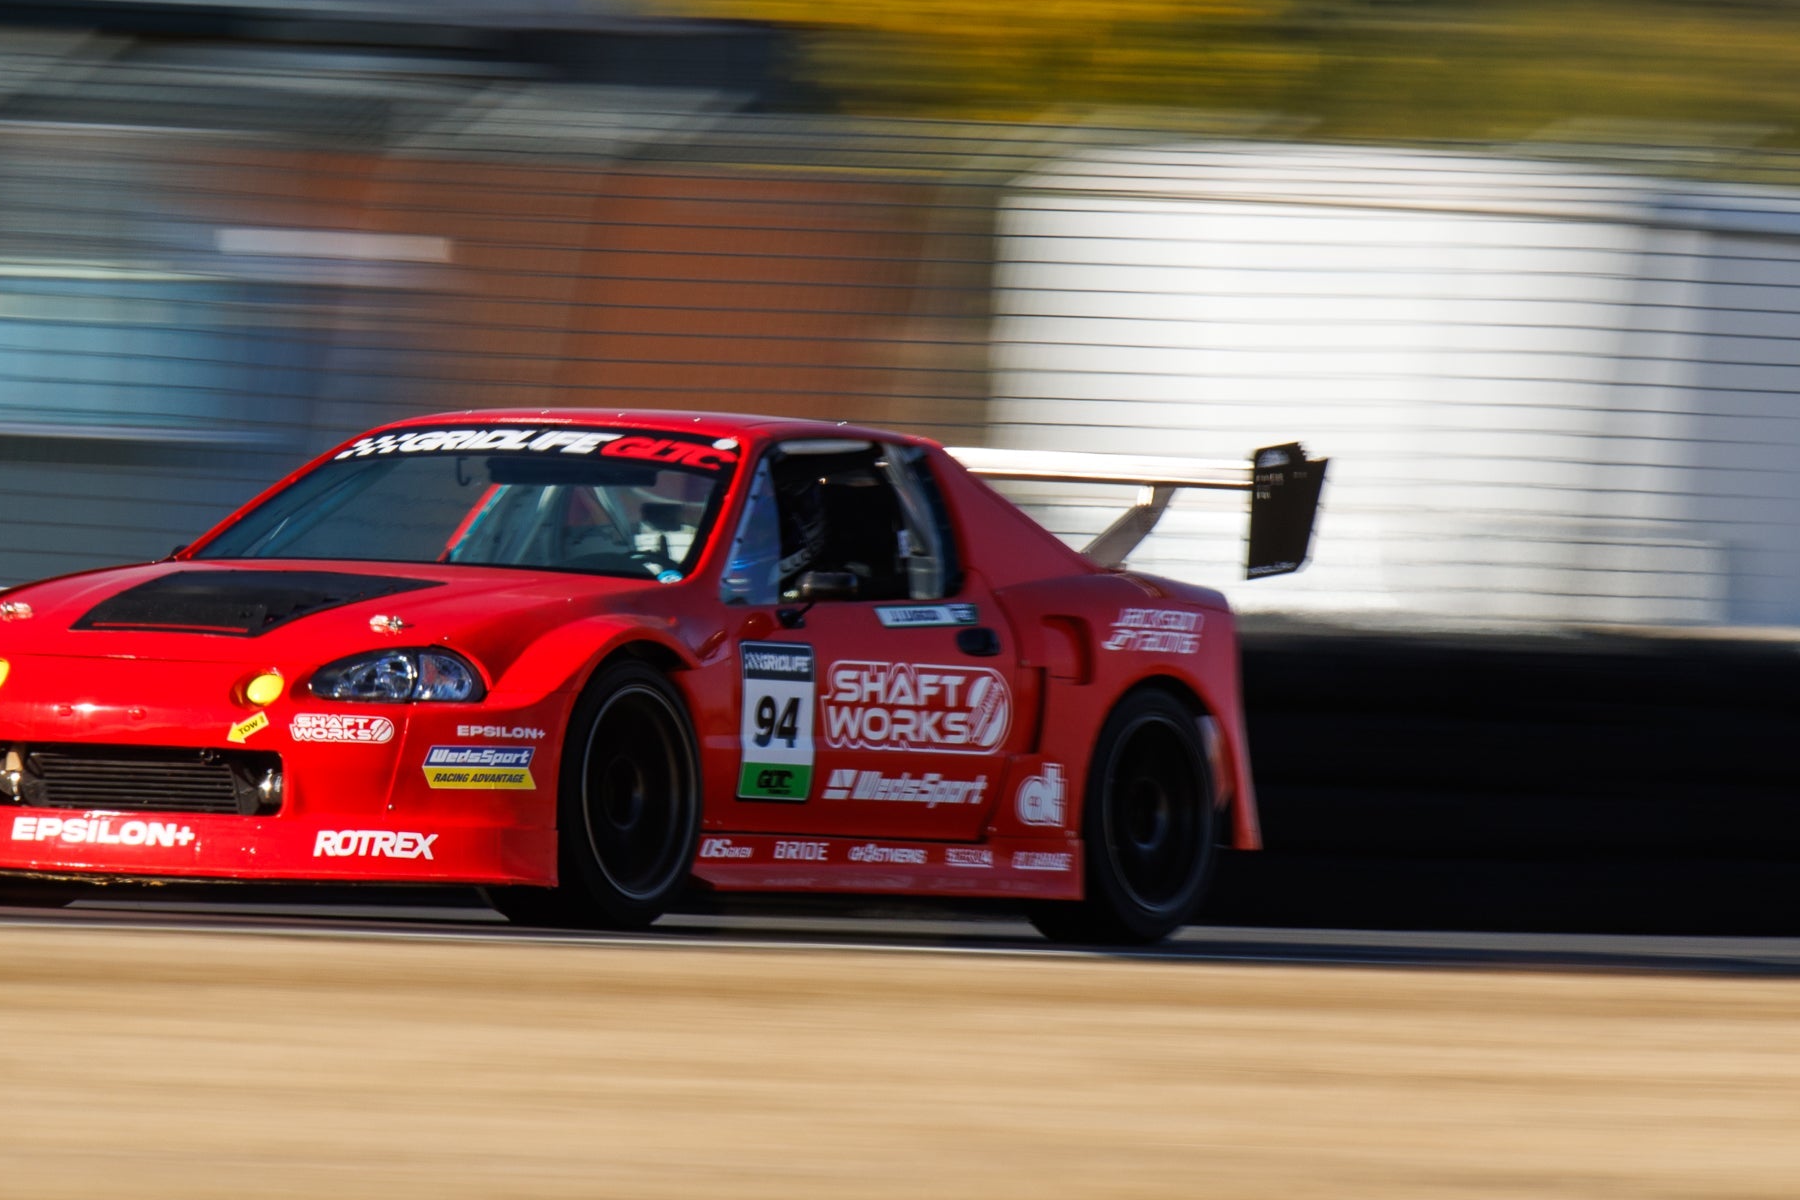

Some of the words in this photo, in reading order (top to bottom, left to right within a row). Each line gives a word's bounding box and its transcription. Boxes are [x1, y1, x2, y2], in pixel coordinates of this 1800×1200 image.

[399, 430, 624, 454] GRIDLIFE
[759, 654, 811, 672] GRIDLIFE
[835, 670, 967, 706] SHAFT
[238, 720, 258, 735] TOW
[297, 716, 369, 729] SHAFT
[753, 695, 801, 748] 94
[827, 706, 969, 744] WORKS
[293, 727, 372, 741] WORKS
[457, 725, 546, 739] EPSILON+
[429, 749, 529, 766] WedsSport
[433, 773, 470, 783] RACING
[470, 773, 525, 783] ADVANTAGE
[11, 817, 195, 846] EPSILON+
[313, 830, 439, 860] ROTREX
[773, 841, 830, 861] BRIDE
